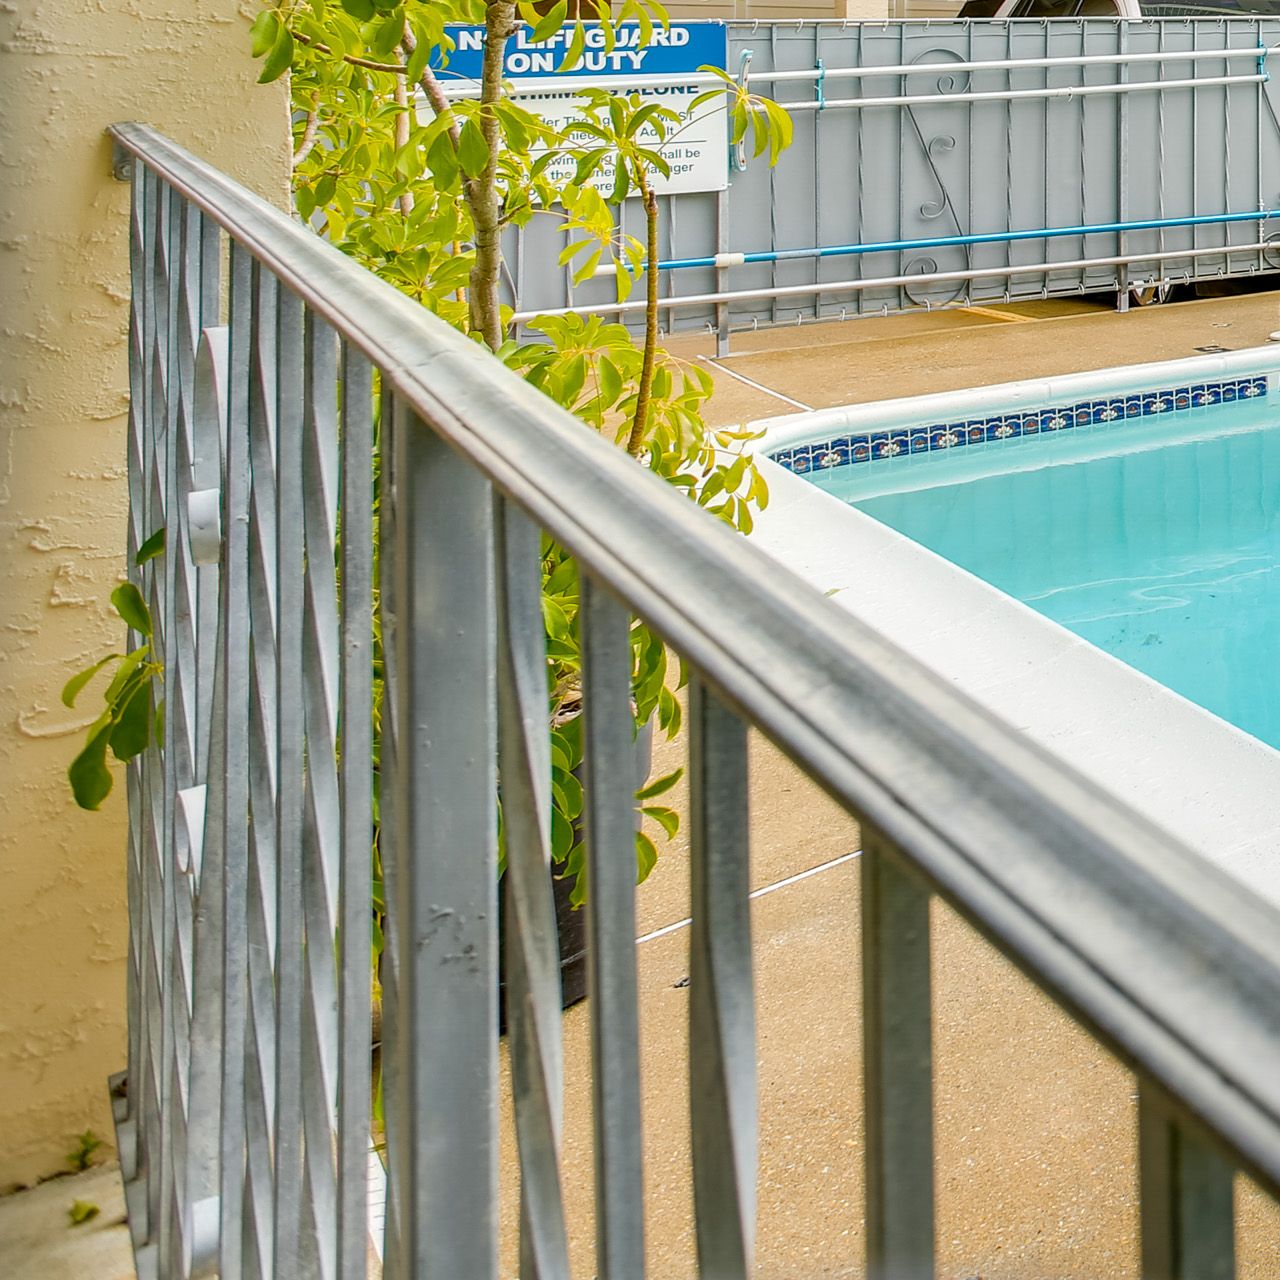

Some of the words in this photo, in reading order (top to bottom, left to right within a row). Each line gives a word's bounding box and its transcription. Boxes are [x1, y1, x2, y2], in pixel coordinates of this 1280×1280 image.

[506, 52, 554, 74] ON
[659, 148, 682, 160] hall
[685, 147, 701, 158] be
